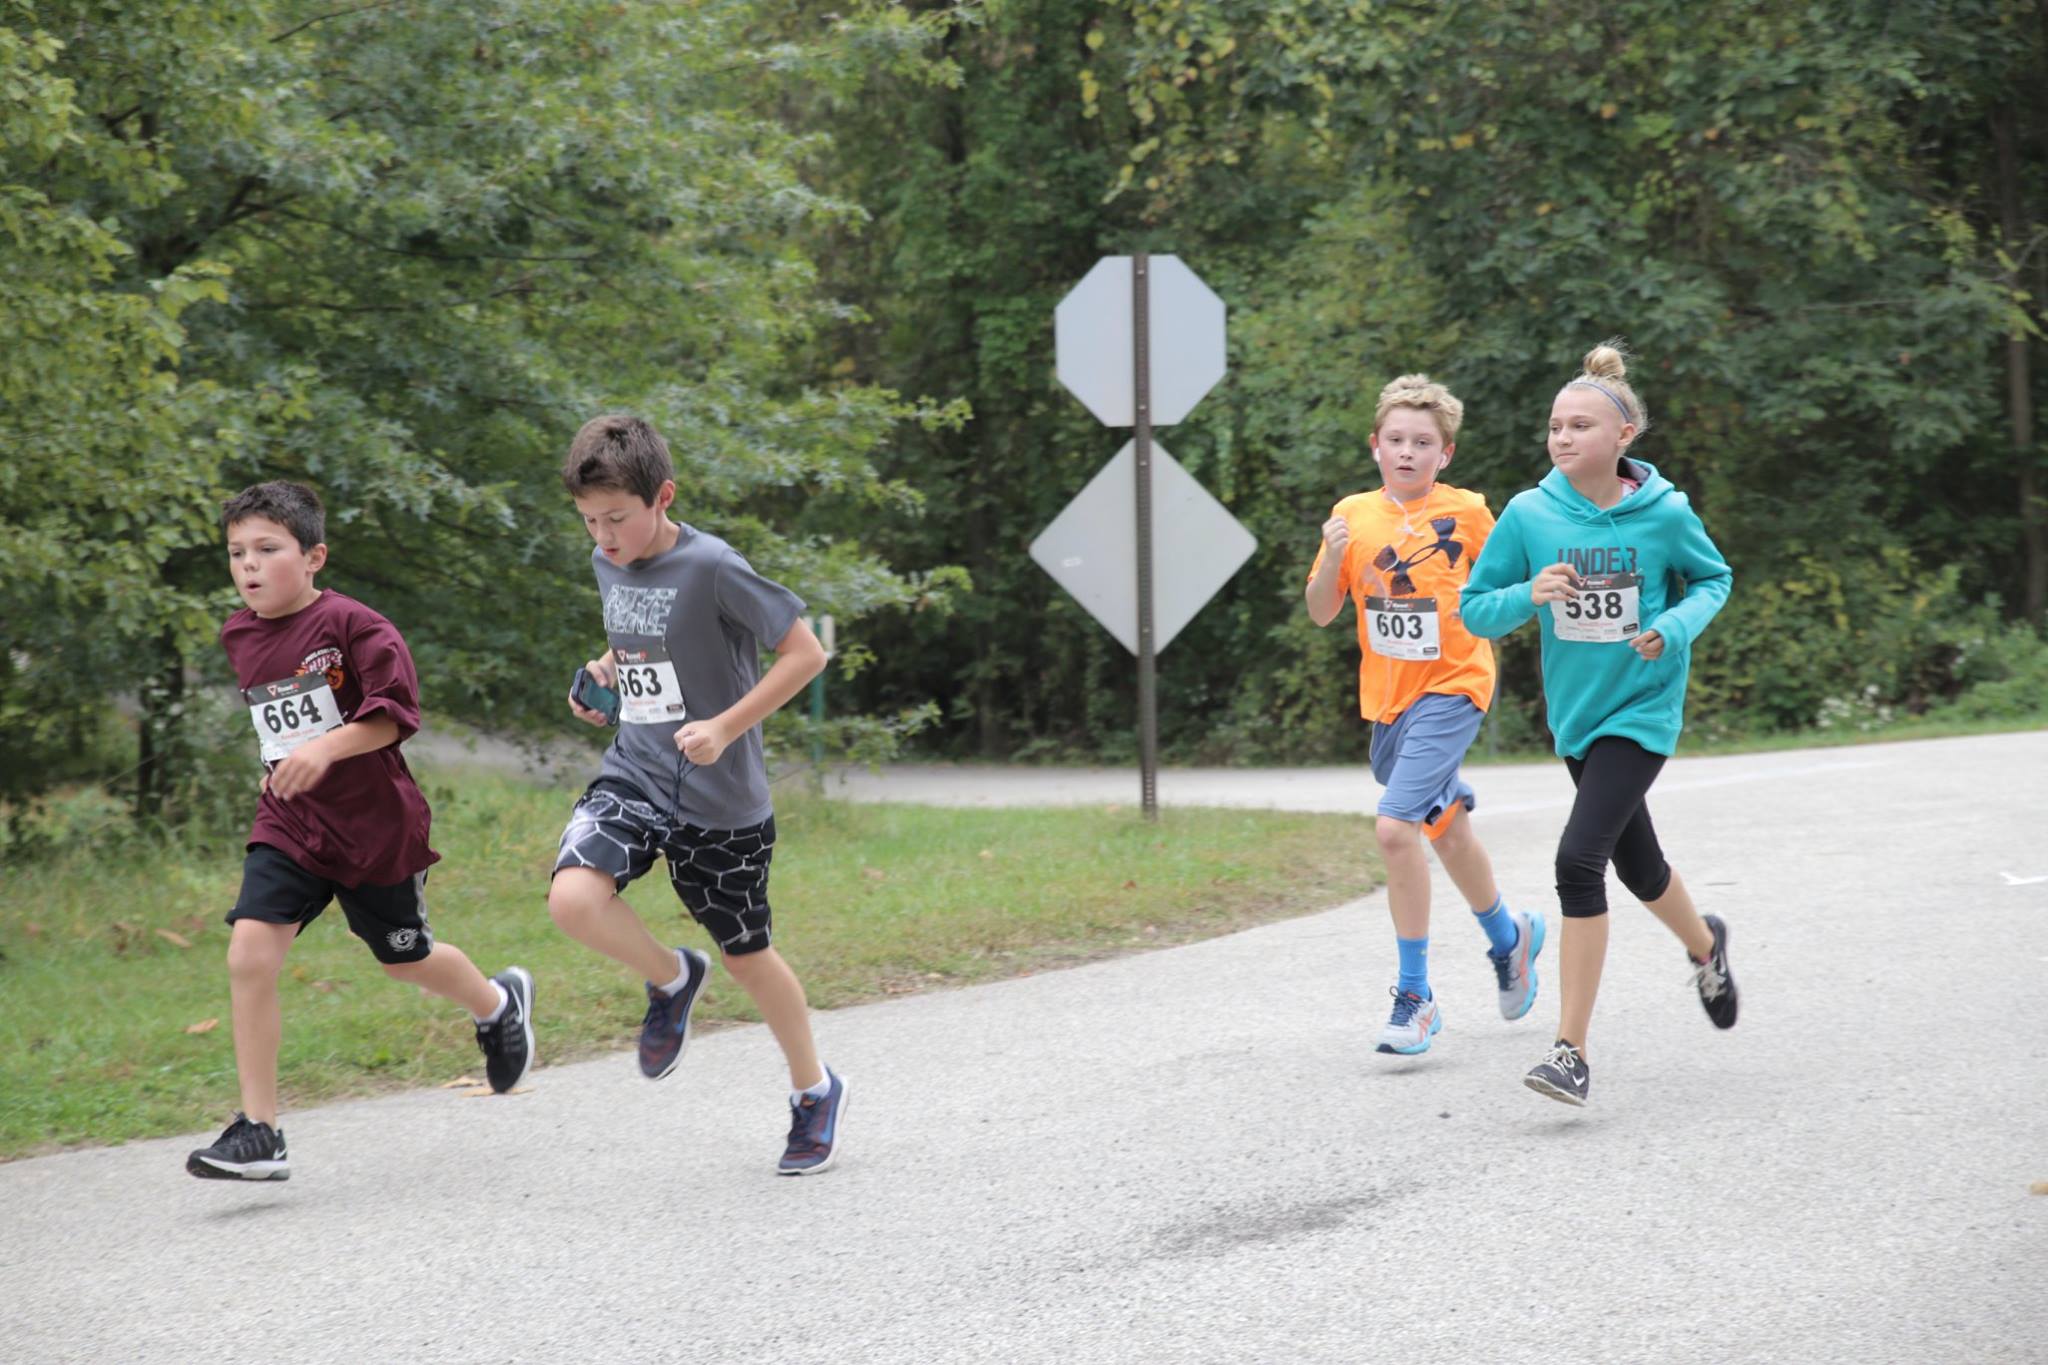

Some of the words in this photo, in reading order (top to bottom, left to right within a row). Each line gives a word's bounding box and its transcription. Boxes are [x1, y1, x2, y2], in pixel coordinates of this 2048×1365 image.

[1566, 592, 1624, 620] 538
[1377, 613, 1423, 640] 603
[263, 694, 323, 734] 664
